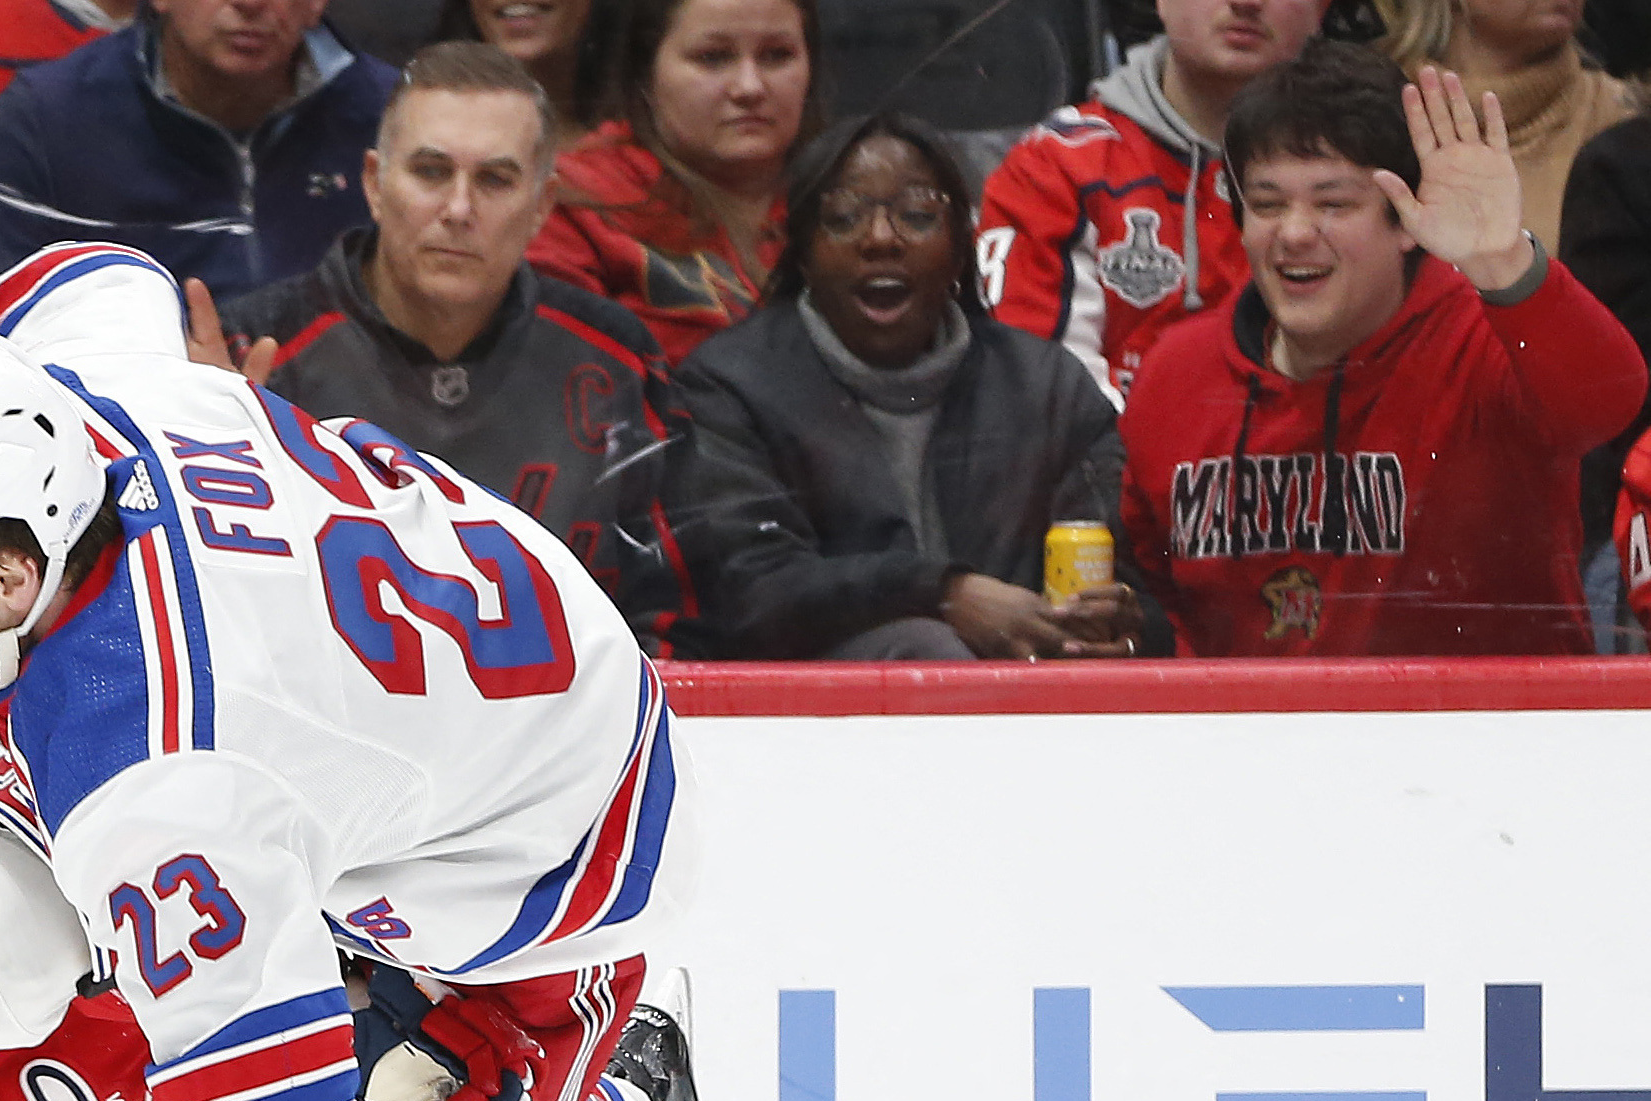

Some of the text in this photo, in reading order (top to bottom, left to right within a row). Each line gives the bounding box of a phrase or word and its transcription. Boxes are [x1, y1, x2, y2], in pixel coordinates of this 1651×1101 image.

[162, 430, 294, 558] FOX
[1171, 450, 1406, 557] MARYLAND
[109, 853, 247, 1000] 23
